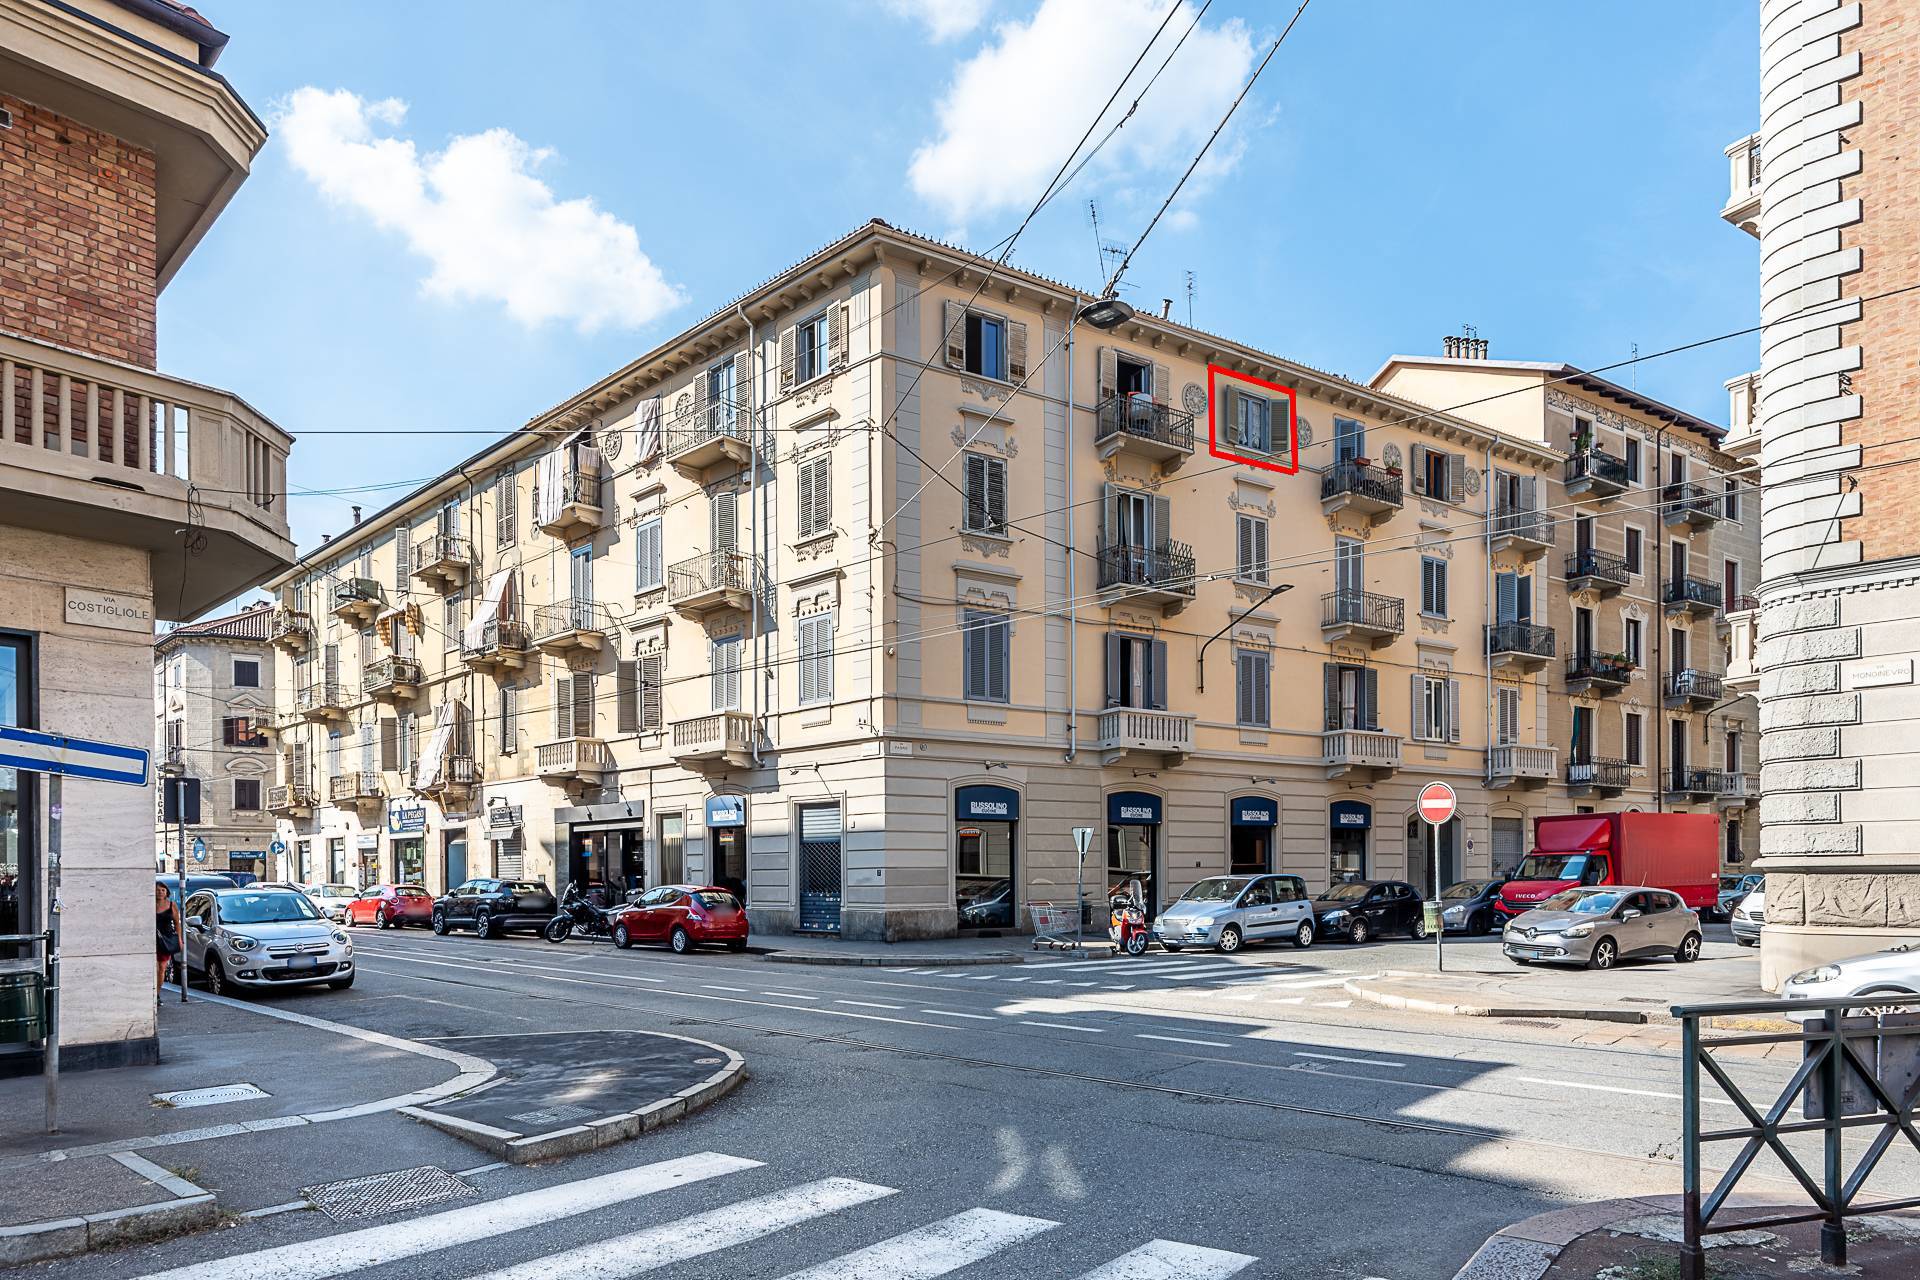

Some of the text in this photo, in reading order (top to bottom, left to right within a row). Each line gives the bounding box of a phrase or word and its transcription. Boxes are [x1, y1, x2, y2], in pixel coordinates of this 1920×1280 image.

[67, 600, 150, 620] COSTIGLIOLE
[971, 801, 1007, 810] BUSSOLINO
[1121, 806, 1152, 814] BUSSOLINO
